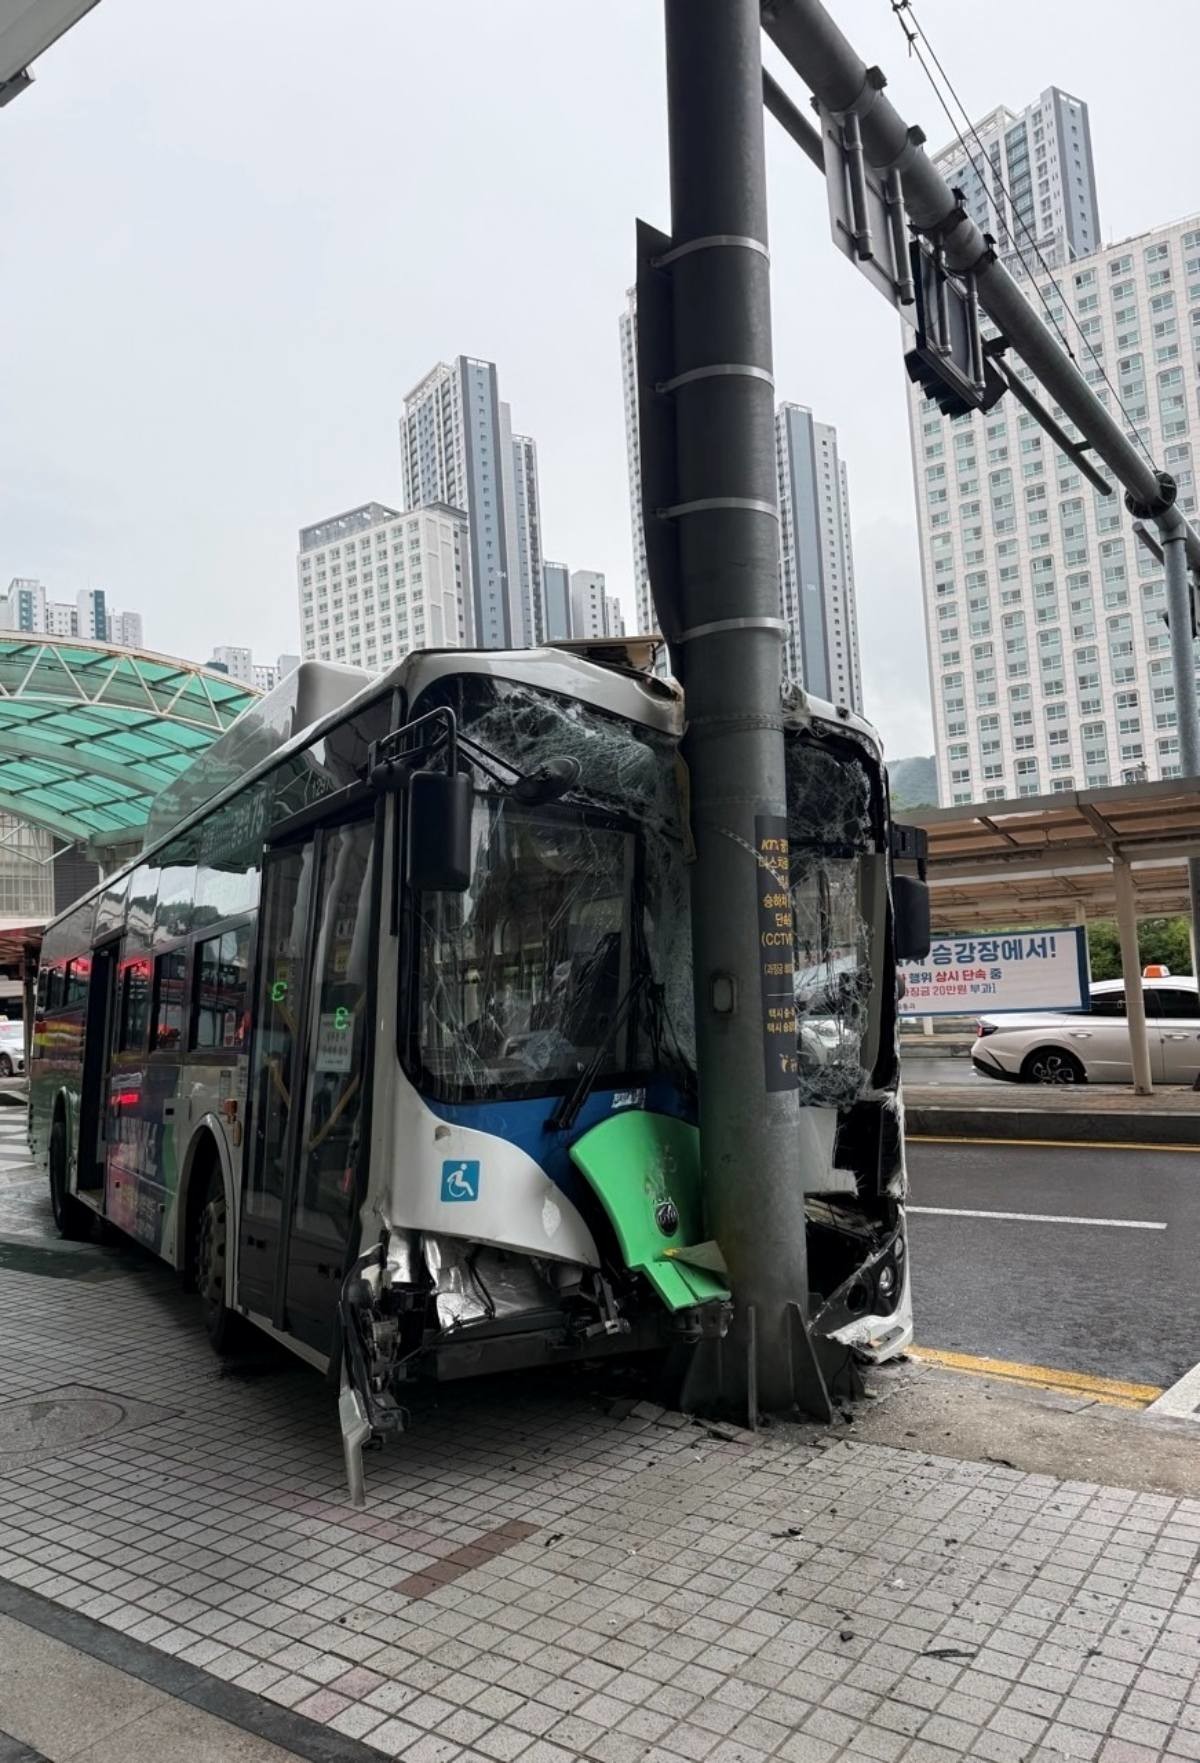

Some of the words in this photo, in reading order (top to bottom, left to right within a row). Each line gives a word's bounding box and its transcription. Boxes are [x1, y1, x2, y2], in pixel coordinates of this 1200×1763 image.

[932, 936, 1056, 965] 승강장에서!
[935, 969, 960, 983] 상시
[962, 968, 987, 981] 단속
[933, 984, 968, 996] 20만원
